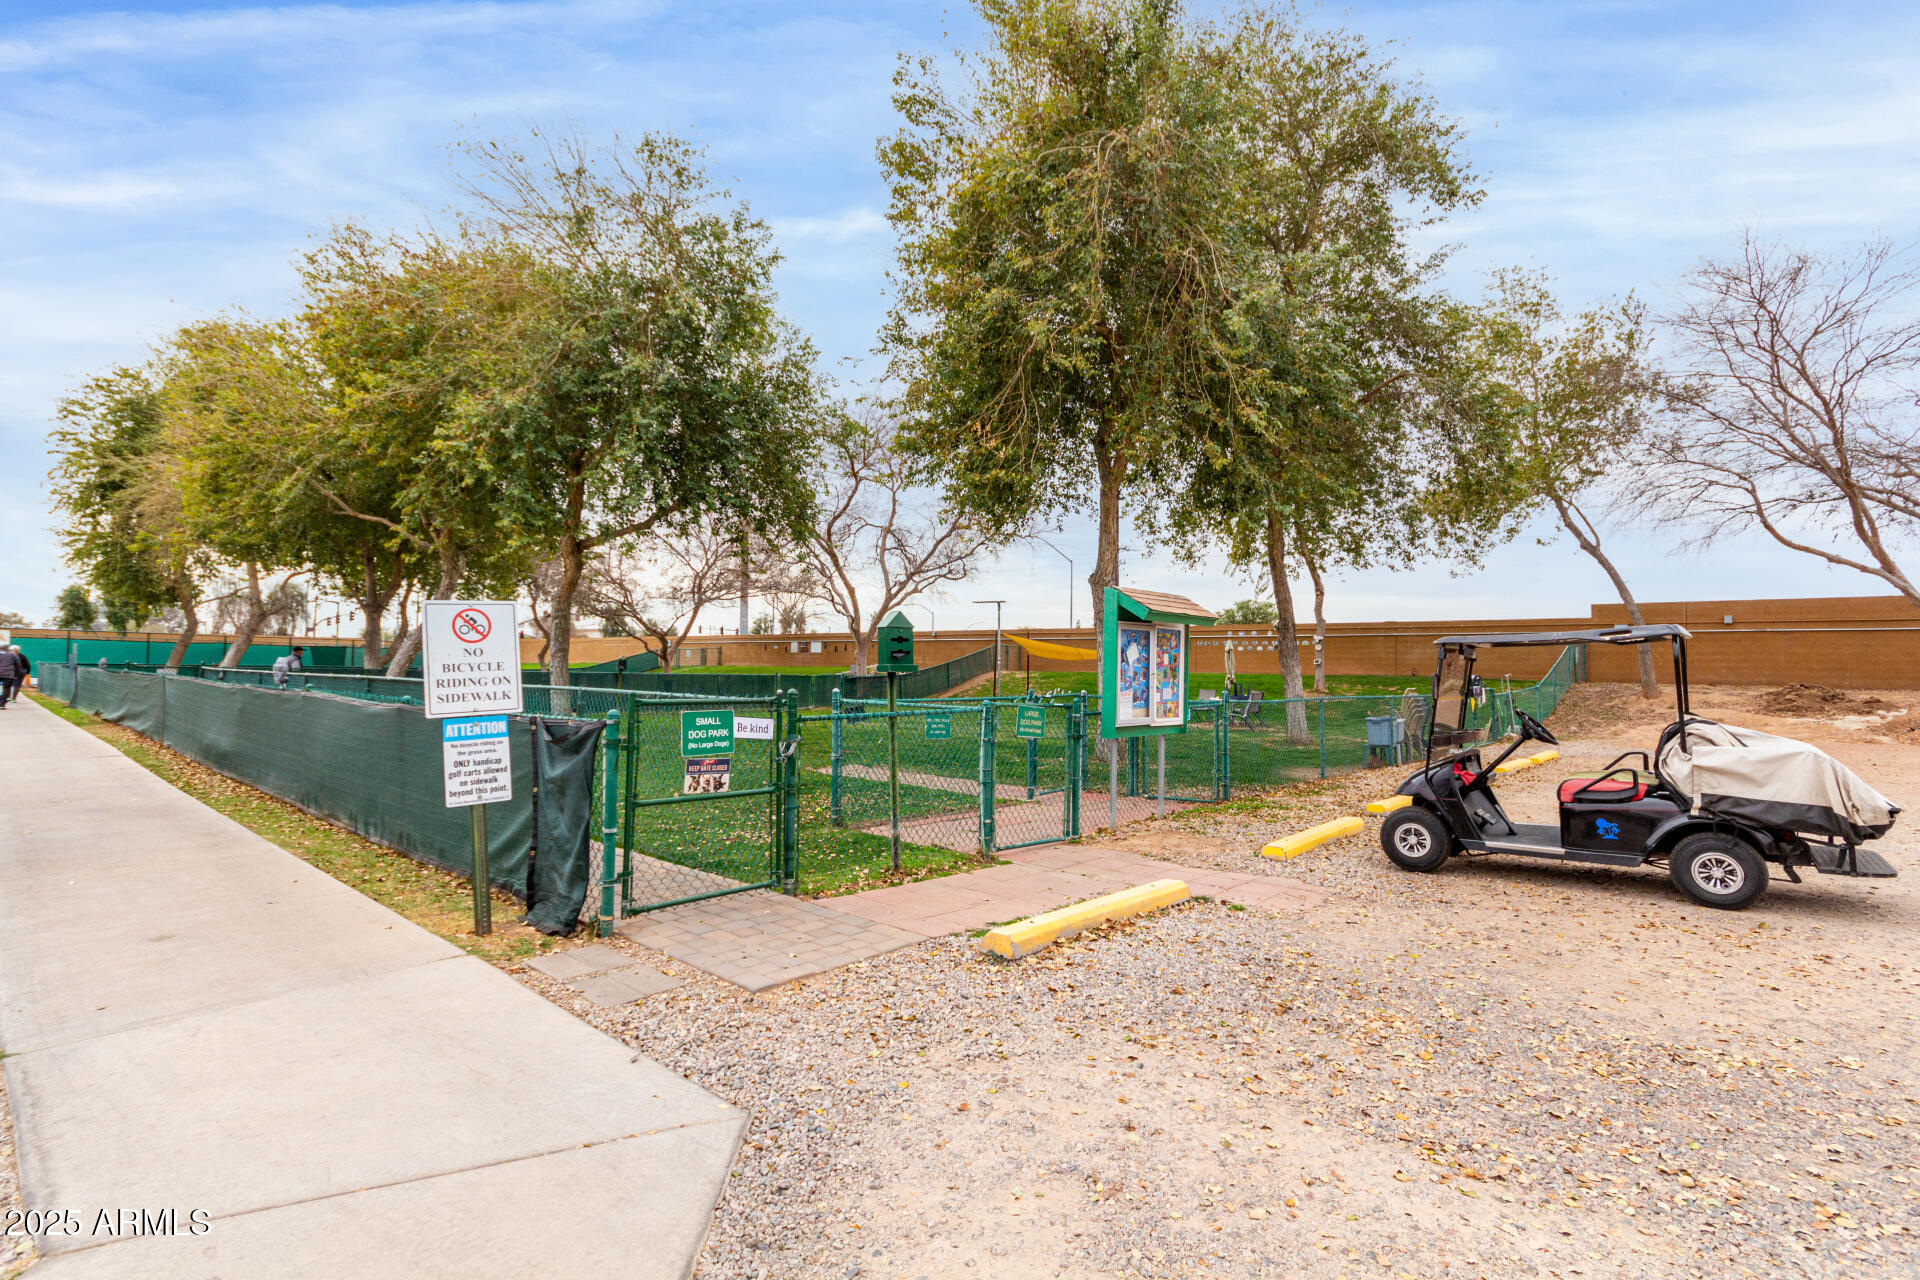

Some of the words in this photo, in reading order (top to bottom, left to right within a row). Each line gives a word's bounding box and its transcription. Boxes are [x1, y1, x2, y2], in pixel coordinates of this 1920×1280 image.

[463, 647, 484, 657] NO
[442, 661, 505, 673] BICYCLE
[436, 677, 488, 689] RIDING
[491, 675, 511, 686] ON
[436, 690, 512, 704] SIDEWALK
[695, 717, 721, 726] SMALL
[445, 720, 507, 738] ATTENTION
[737, 722, 748, 733] Be
[749, 723, 769, 734] kind
[688, 730, 707, 739] DOG
[708, 729, 729, 737] PARK
[688, 742, 698, 750] (No
[698, 741, 713, 749] Large
[714, 740, 730, 748] Dogs)
[453, 759, 471, 768] ONLY
[473, 757, 502, 766] handicap
[700, 764, 712, 772] GATE
[448, 769, 462, 780] golf
[464, 768, 481, 777] carts
[483, 765, 508, 775] allowed
[470, 775, 498, 785] sidewalk
[449, 788, 473, 798] beyond
[475, 786, 488, 795] this
[490, 784, 509, 794] point.
